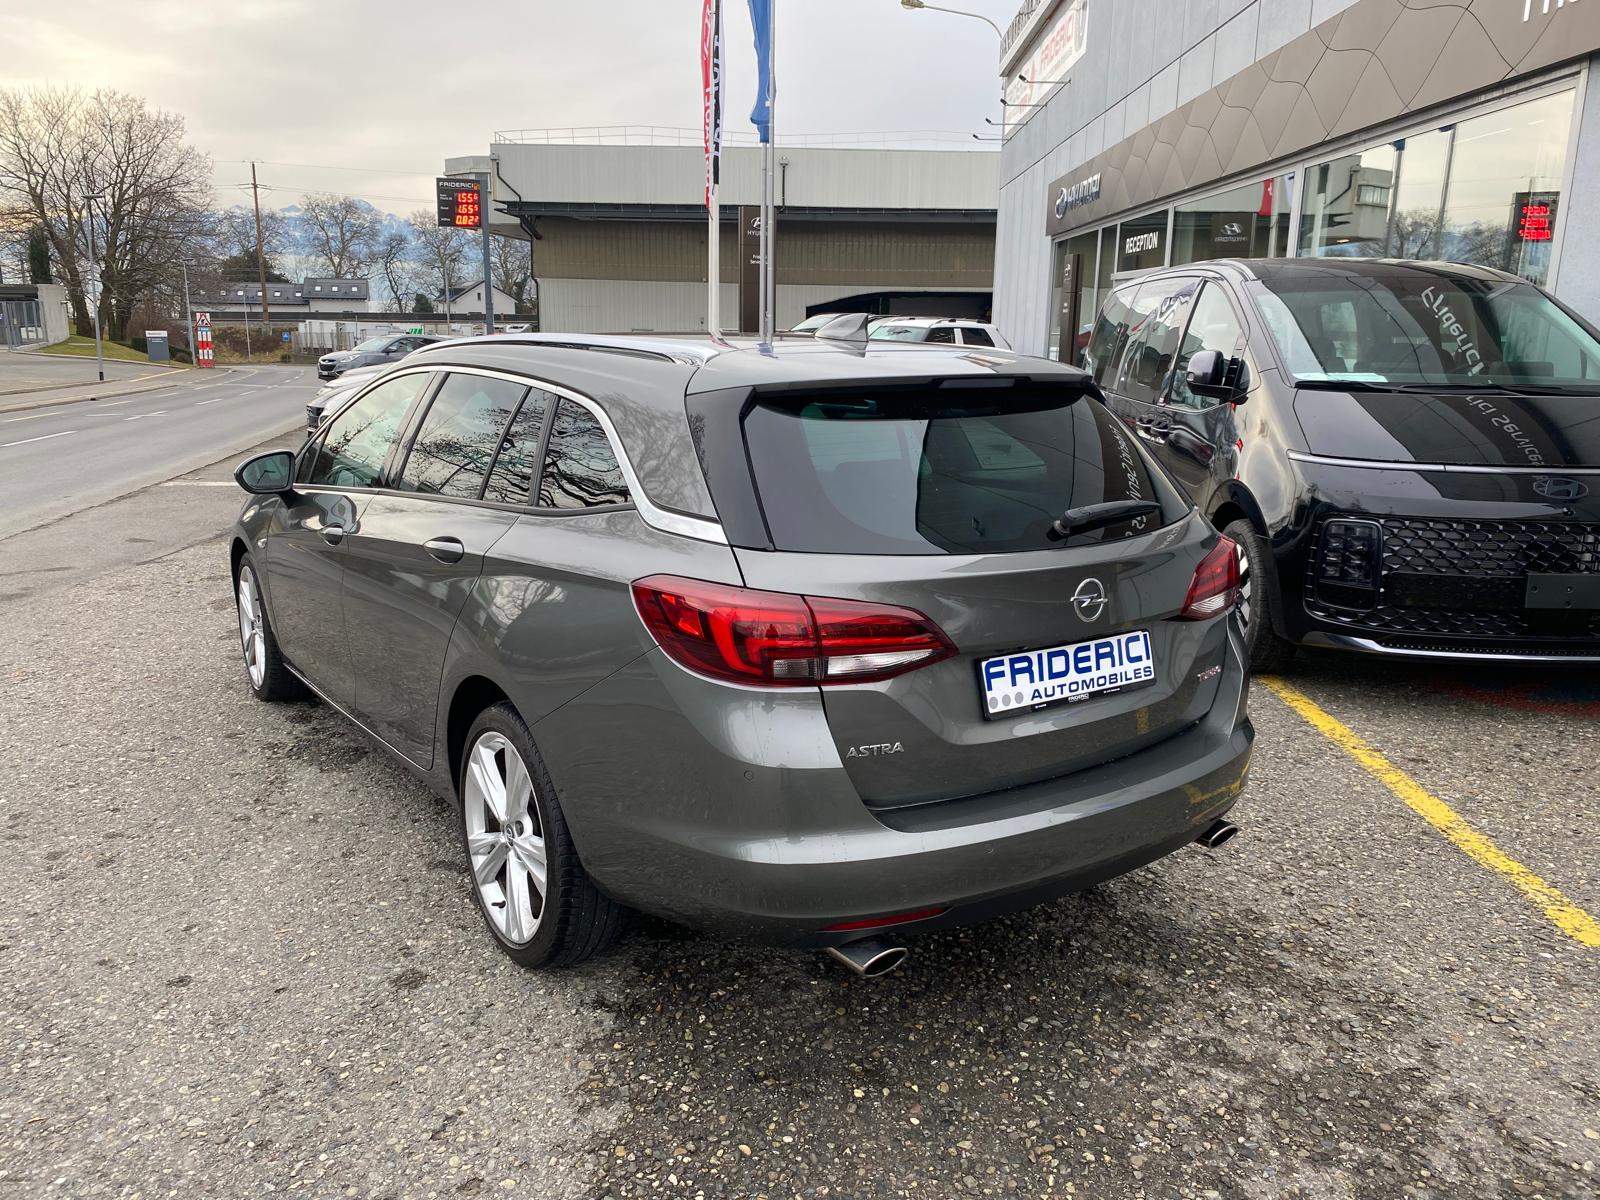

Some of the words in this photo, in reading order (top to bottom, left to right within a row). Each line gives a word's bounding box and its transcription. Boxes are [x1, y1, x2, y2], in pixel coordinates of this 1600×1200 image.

[439, 181, 474, 189] FRIDERICI
[1125, 231, 1159, 254] RECEPTION
[985, 633, 1151, 692] FRIDERICI
[1031, 665, 1153, 701] AUTOMOBILES
[846, 741, 905, 759] ASTRA
